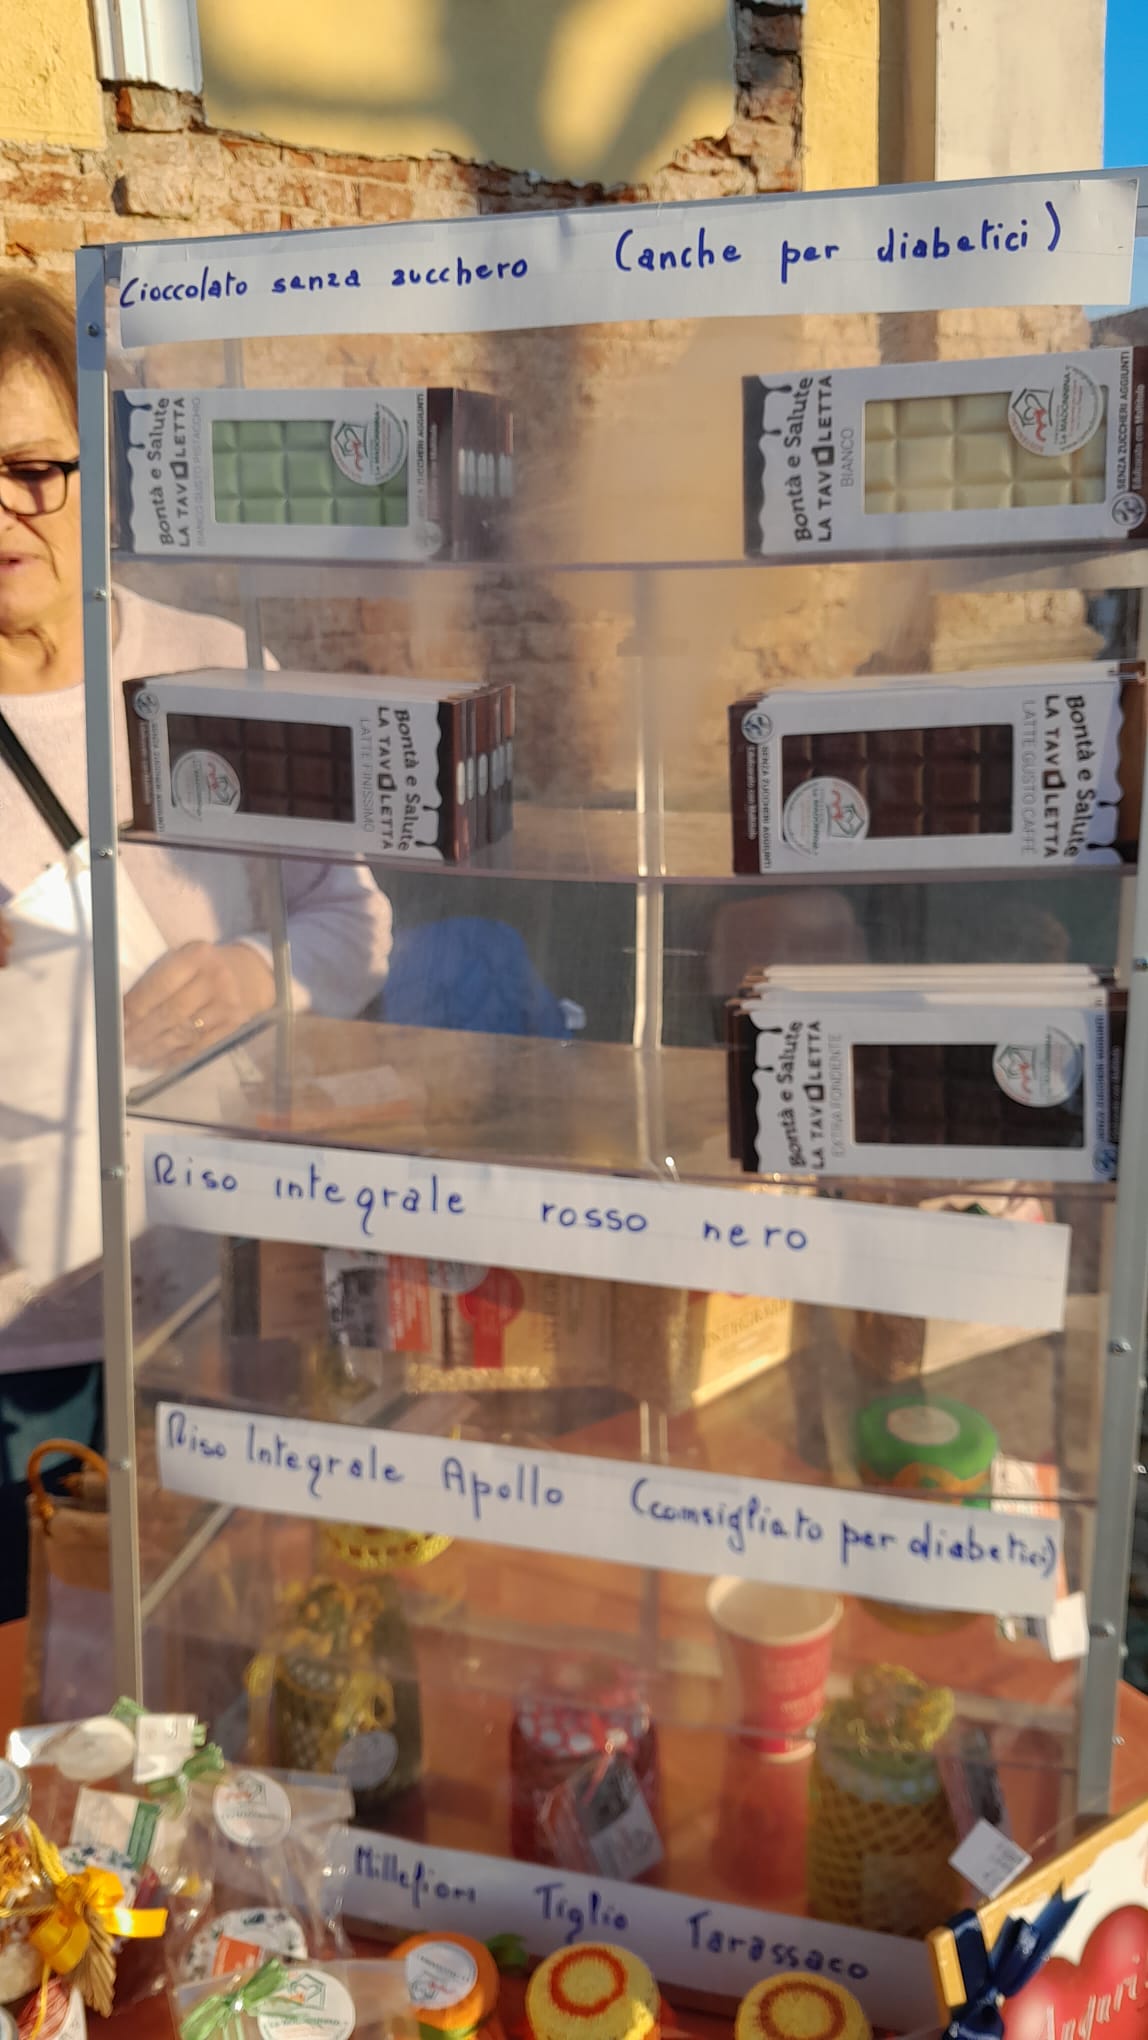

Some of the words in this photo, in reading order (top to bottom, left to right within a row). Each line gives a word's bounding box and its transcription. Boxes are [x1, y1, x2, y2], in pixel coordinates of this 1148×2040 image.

[119, 266, 249, 308] Cioccolato
[271, 270, 362, 294] senza
[391, 256, 529, 287] zucchero
[781, 240, 840, 284] per
[1119, 351, 1130, 400] AGGIUNTI
[147, 398, 169, 461] Salute
[784, 377, 813, 448] Salute
[1117, 403, 1128, 454] ZUCCHERI
[151, 469, 161, 479] e
[787, 455, 800, 468] e
[840, 428, 854, 487] BIANCO
[1117, 457, 1127, 490] SENZA
[150, 486, 175, 546] Bontà
[179, 526, 190, 547] LA
[785, 475, 812, 542] Bontà
[819, 518, 832, 542] LA
[378, 707, 390, 728] LA
[1022, 700, 1036, 748] LATTE
[1045, 695, 1060, 718] LA
[1065, 695, 1096, 762] Bontà
[360, 719, 373, 761] LATTE
[394, 709, 419, 769] Bontà
[362, 764, 375, 832] FINISSIMO
[406, 776, 417, 786] e
[1021, 751, 1036, 805] GUSTO
[1078, 769, 1091, 780] e
[398, 793, 421, 851] Salute
[1064, 789, 1097, 858] Salute
[776, 1021, 803, 1084] Salute
[780, 1091, 793, 1102] e
[779, 1108, 806, 1168] Bontà
[812, 1148, 824, 1170] LA
[154, 1153, 238, 1191] Riso
[275, 1163, 466, 1236] integrale
[541, 1202, 648, 1234] rosso
[703, 1218, 808, 1250] nero
[167, 1411, 227, 1459] Riso
[247, 1423, 403, 1498] Integrale
[442, 1456, 564, 1520] Apollo
[841, 1519, 896, 1566] per
[535, 1882, 629, 1942] Tiglio
[687, 1911, 870, 1981] Tarassaco
